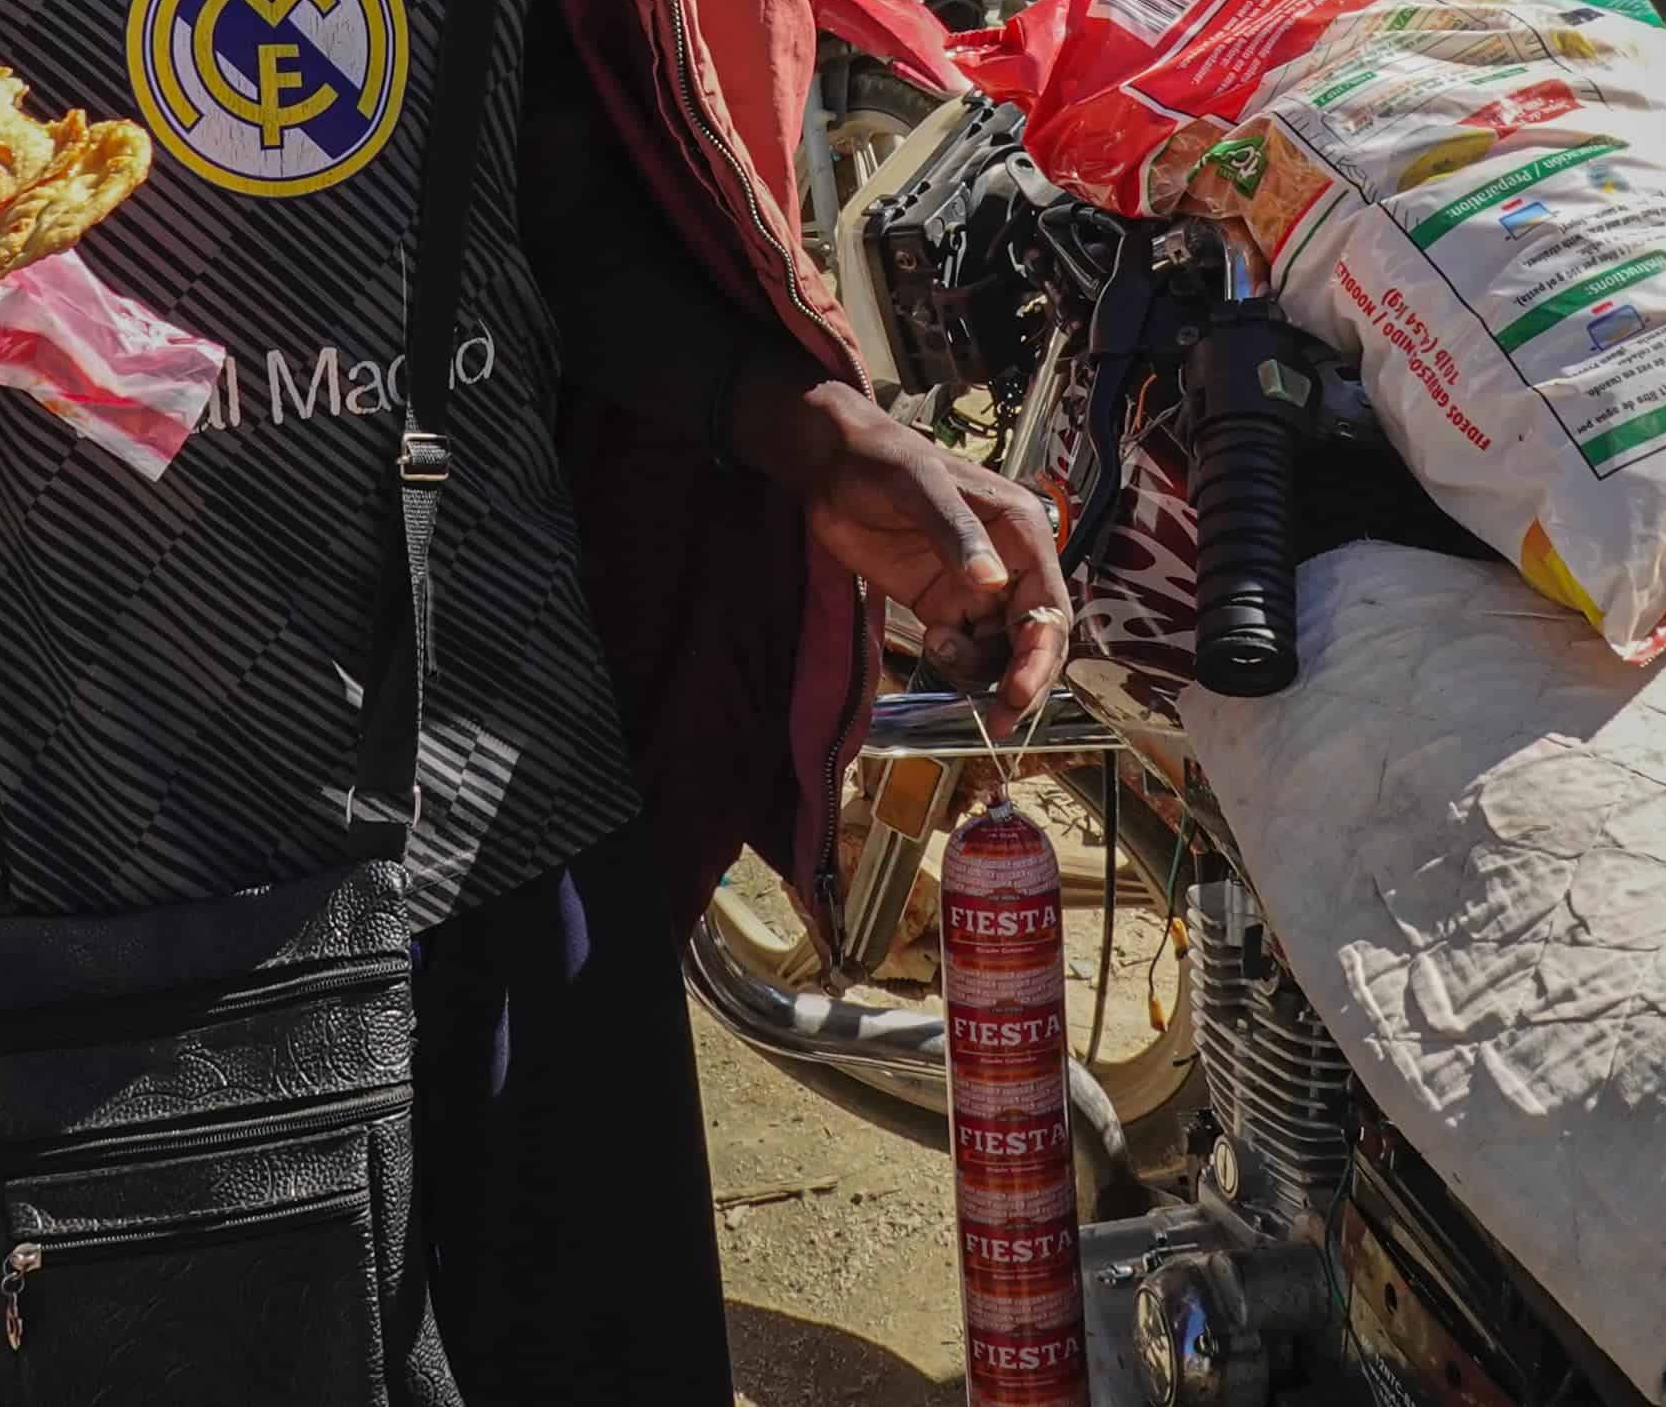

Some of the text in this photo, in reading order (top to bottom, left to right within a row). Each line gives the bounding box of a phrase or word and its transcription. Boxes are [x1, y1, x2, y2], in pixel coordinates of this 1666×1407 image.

[1445, 168, 1532, 218] Preparation:
[1382, 322, 1417, 356] NIDO
[1446, 404, 1492, 451] FIDEOS
[950, 904, 1057, 937] FIESTA
[954, 1015, 1063, 1048] FIESTA
[959, 1124, 1068, 1157] FIESTA
[965, 1230, 1074, 1263] FIESTA
[972, 1337, 1081, 1370] FIESTA
